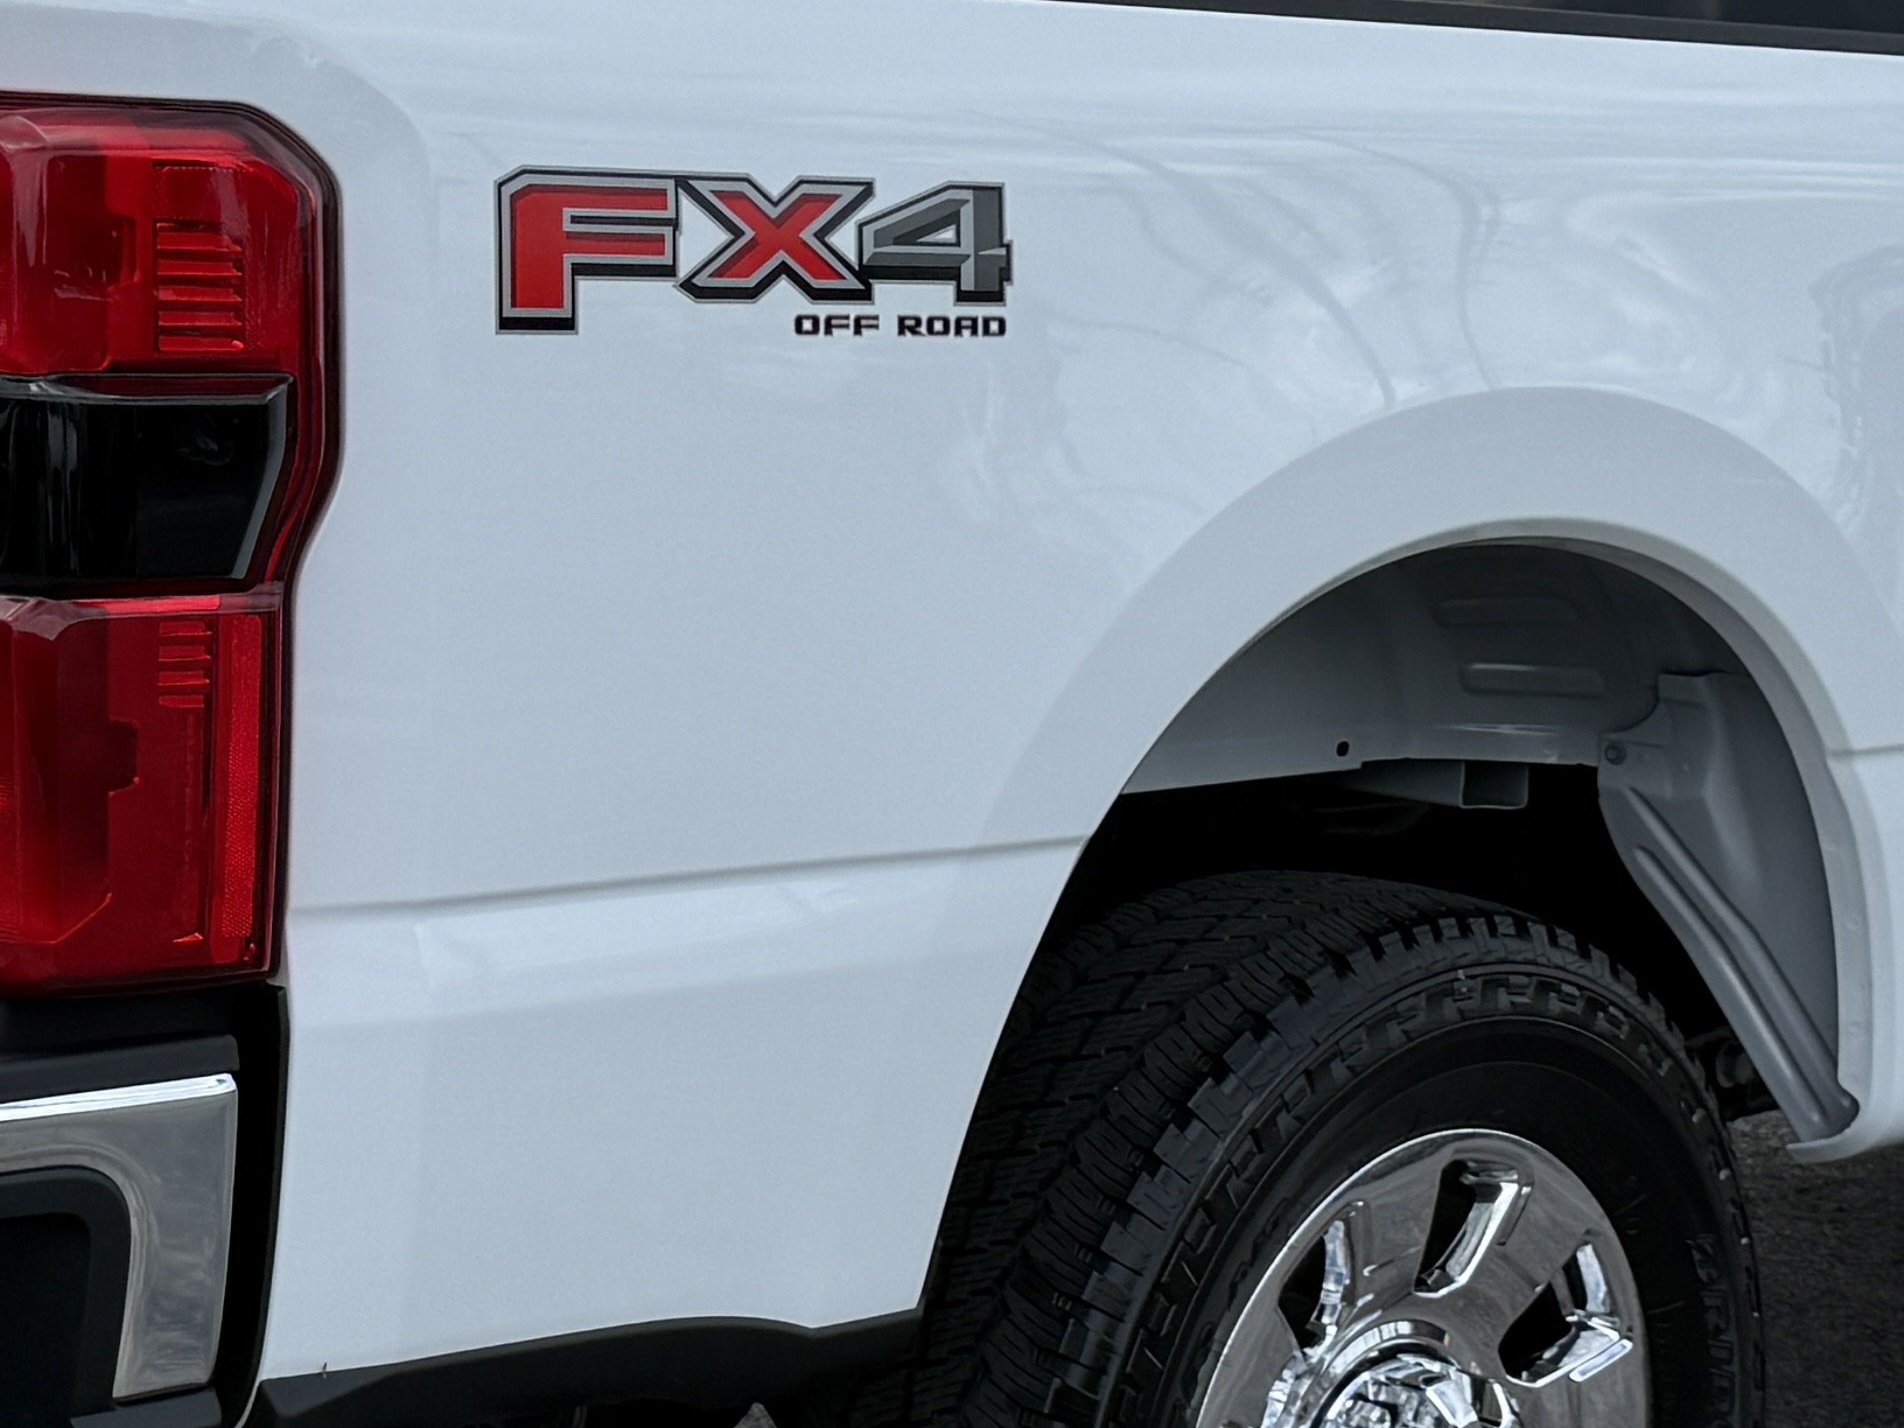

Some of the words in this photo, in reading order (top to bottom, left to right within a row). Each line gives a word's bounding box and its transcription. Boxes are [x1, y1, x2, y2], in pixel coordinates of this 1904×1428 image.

[494, 164, 1013, 335] FX4
[794, 312, 880, 337] OFF
[896, 314, 1008, 338] ROAD
